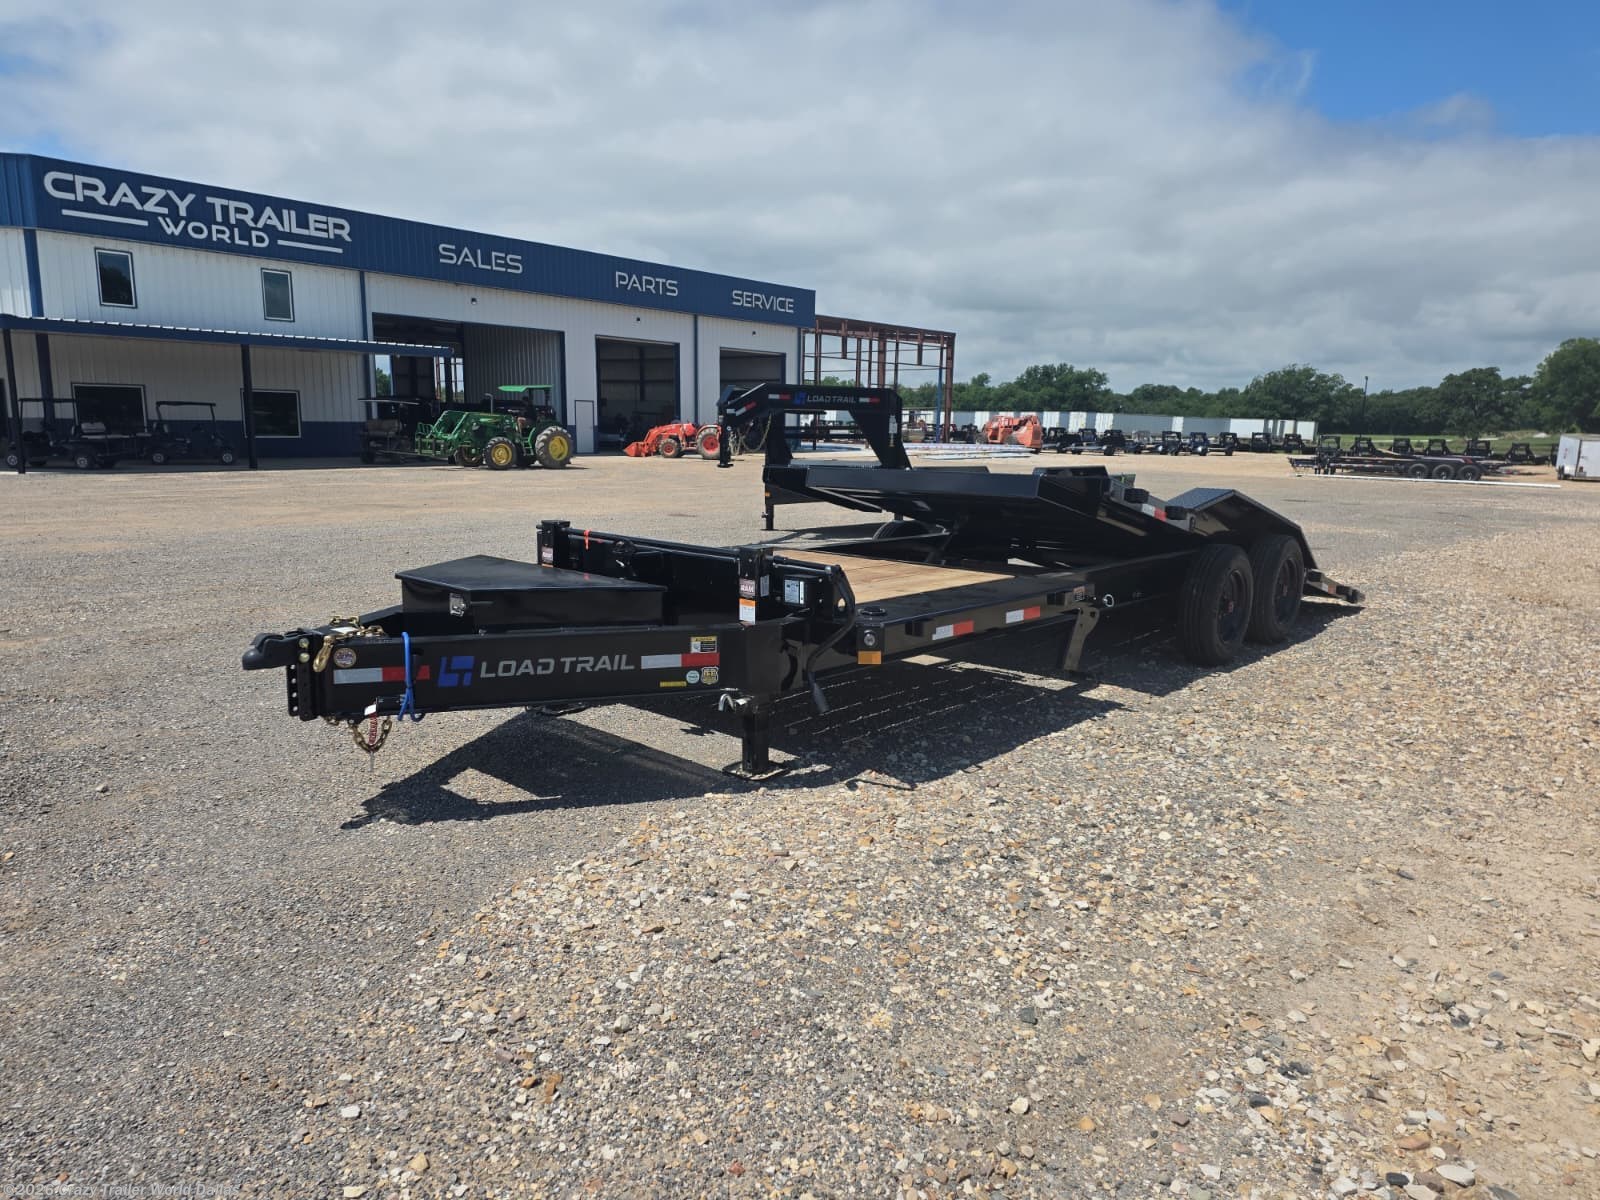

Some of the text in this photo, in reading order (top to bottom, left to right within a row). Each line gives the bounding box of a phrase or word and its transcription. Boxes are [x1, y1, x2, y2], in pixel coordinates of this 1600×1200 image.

[43, 171, 352, 242] CRAZY TRAILER
[157, 217, 270, 248] WORLD
[438, 243, 523, 274] SALES
[615, 271, 679, 297] PARTS
[731, 289, 795, 314] SERVICE
[807, 395, 857, 404] LOAD TRAIL
[480, 653, 635, 679] LOAD TRAIL
